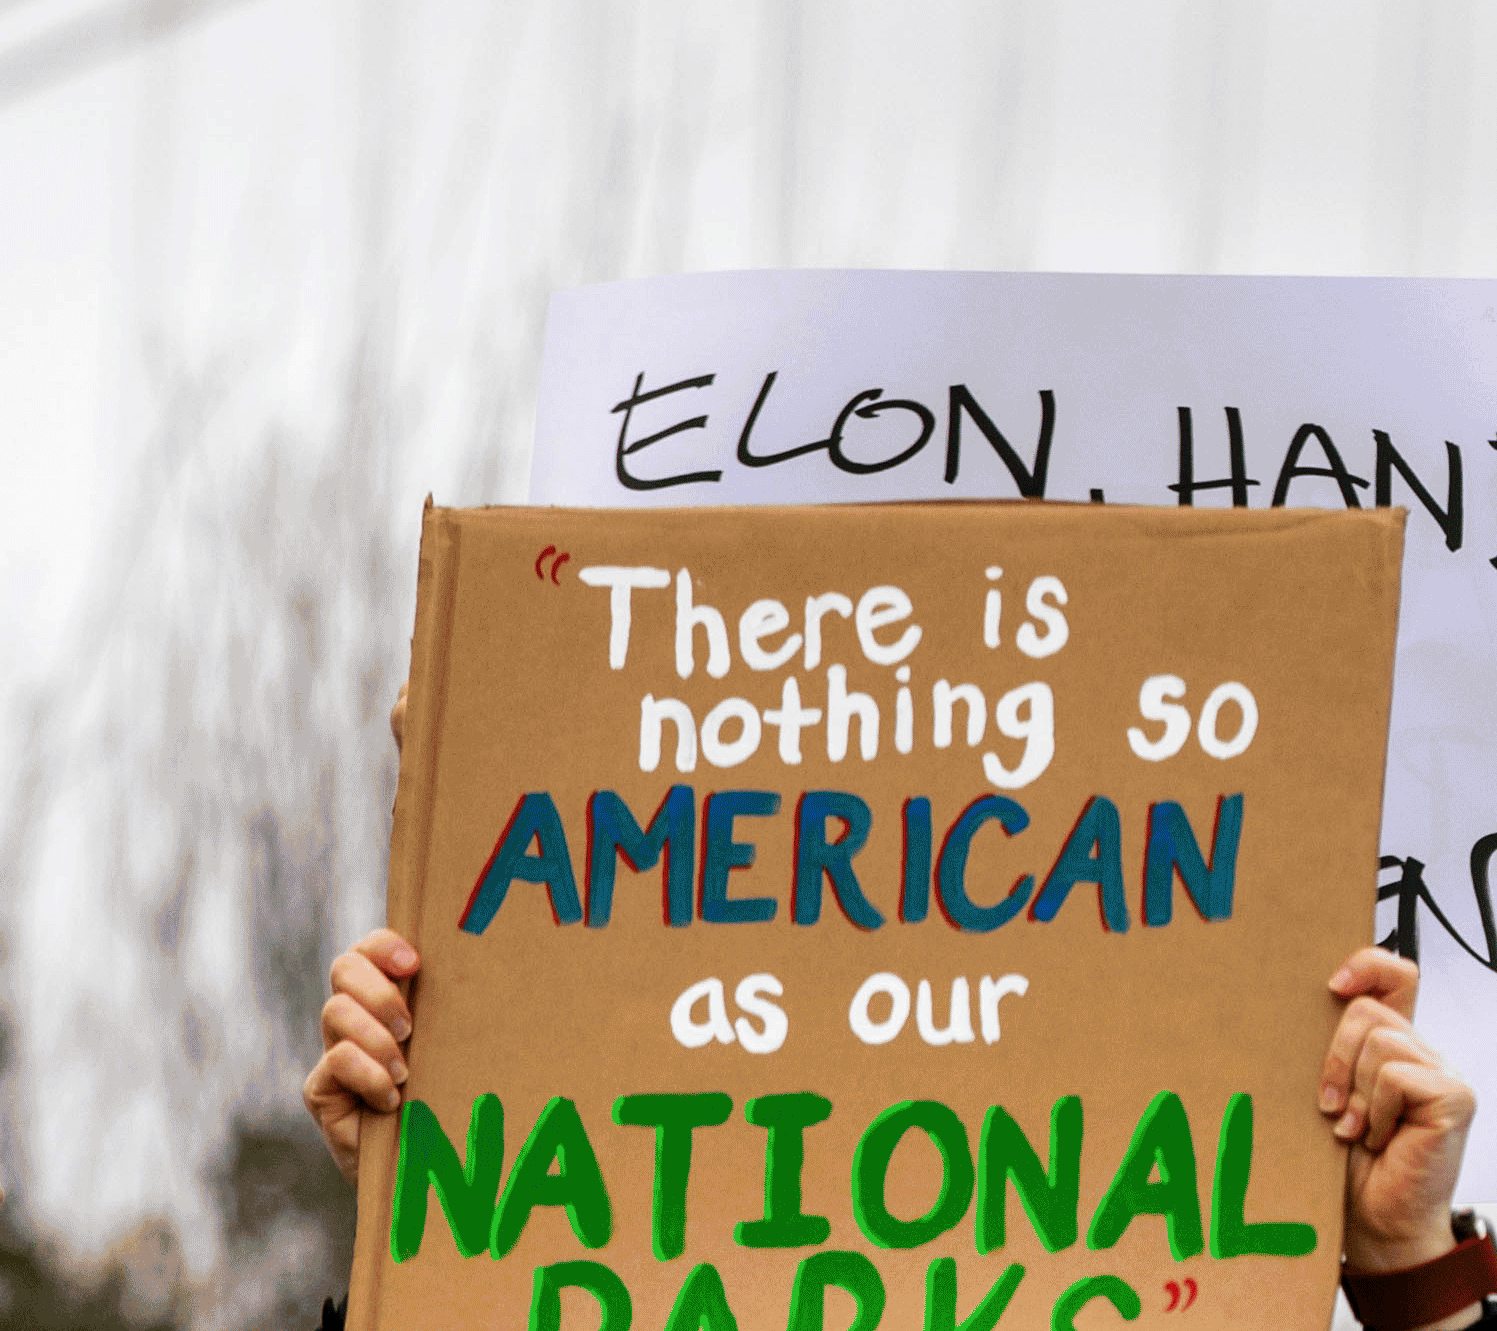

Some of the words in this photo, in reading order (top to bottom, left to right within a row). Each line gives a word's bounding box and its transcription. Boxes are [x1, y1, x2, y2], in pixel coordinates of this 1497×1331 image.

[985, 568, 1068, 657] is
[638, 664, 1056, 789] nothing
[1128, 676, 1258, 760] so
[458, 785, 1243, 934] AMERICAN
[671, 974, 787, 1053] as
[849, 973, 1028, 1045] our
[389, 1089, 1319, 1263] NATIONAL
